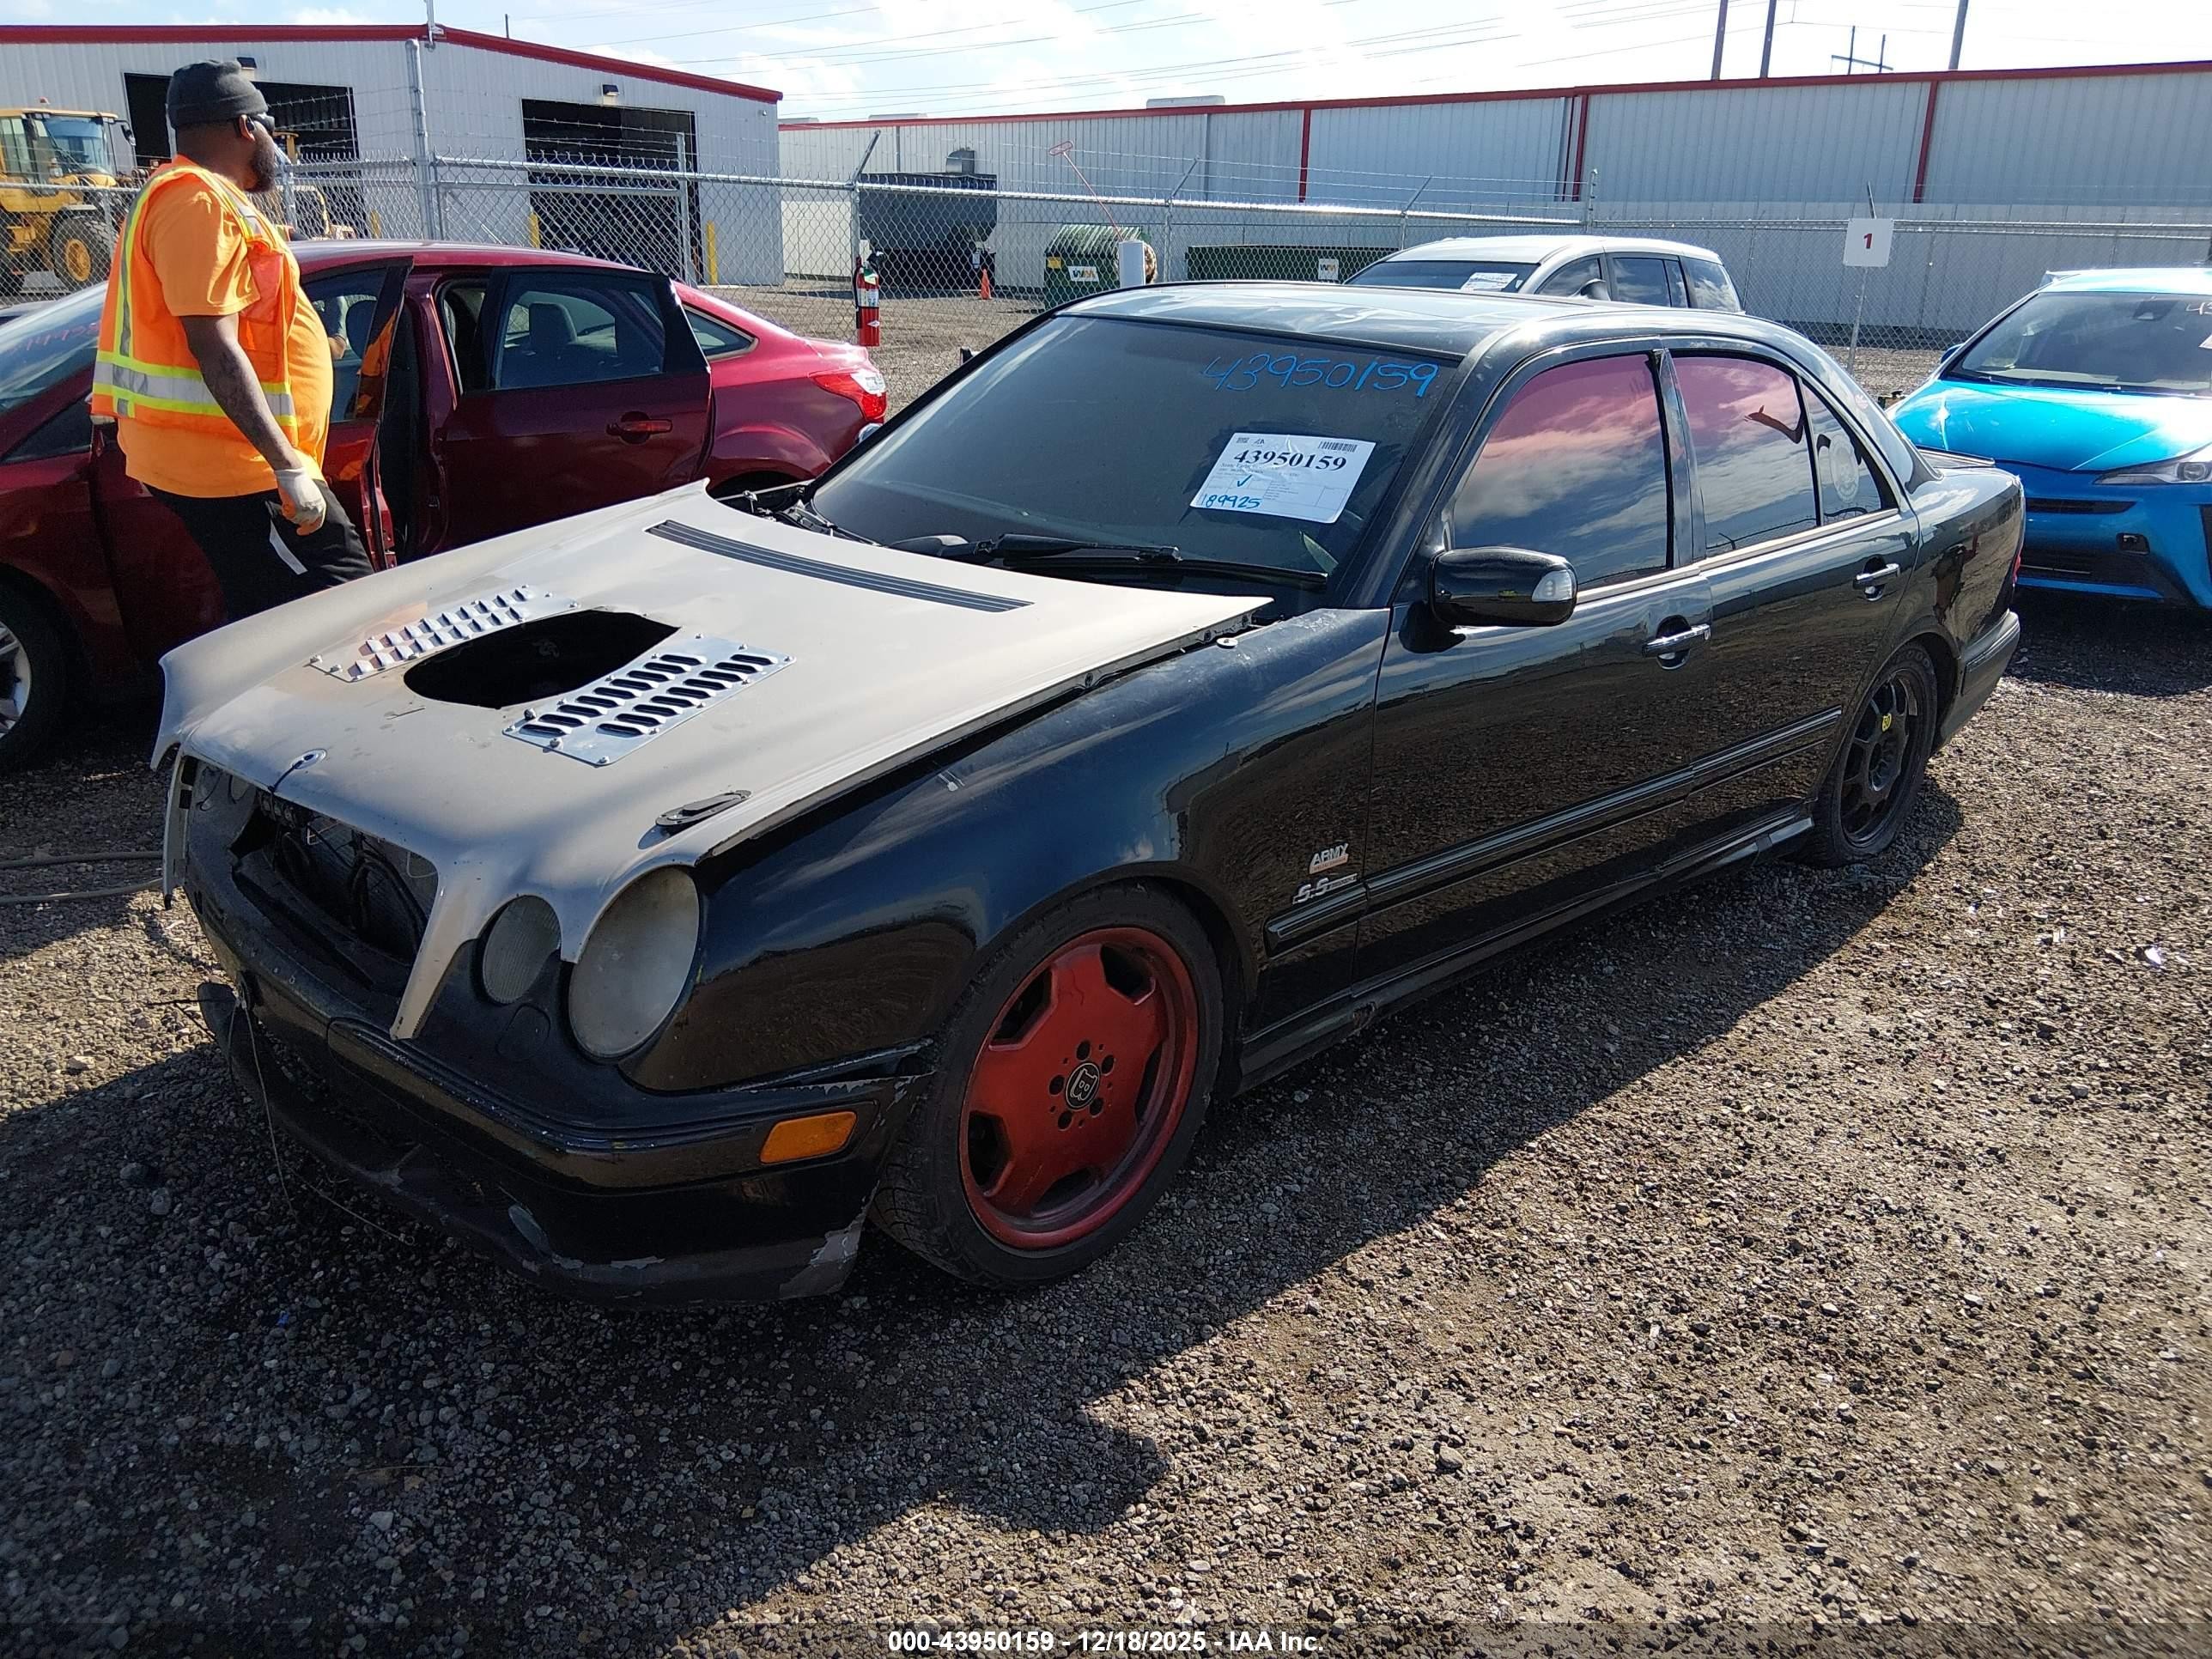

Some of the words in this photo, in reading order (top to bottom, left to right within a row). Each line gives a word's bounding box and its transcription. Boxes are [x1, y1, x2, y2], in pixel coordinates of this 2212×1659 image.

[1863, 233, 1873, 249] 1
[1200, 352, 1440, 398] 43950159
[1233, 449, 1347, 471] 43950159
[1310, 842, 1349, 867] ARMY
